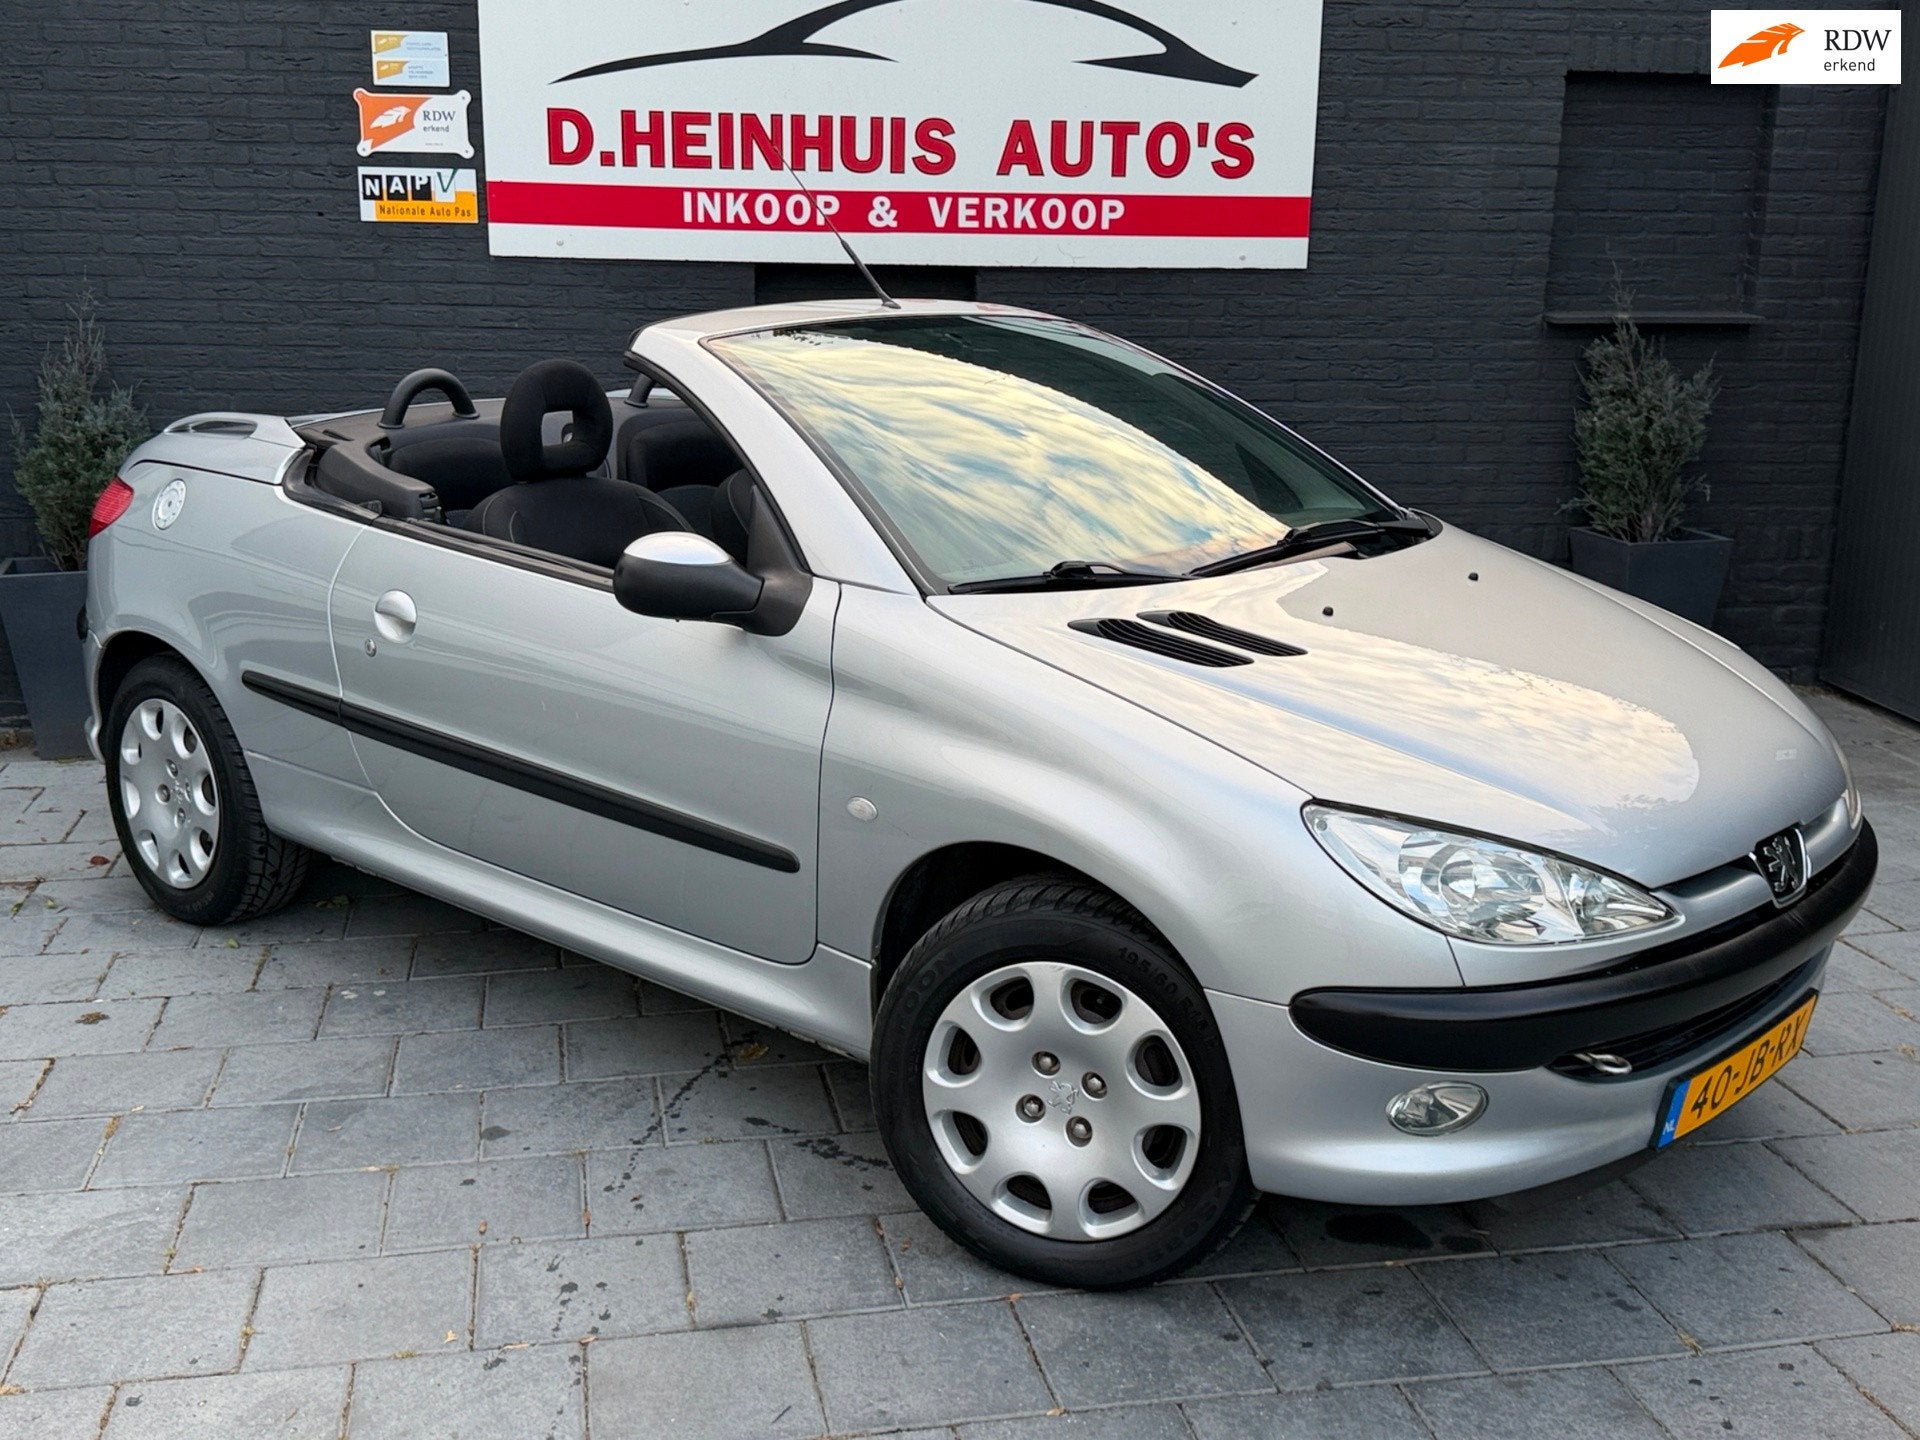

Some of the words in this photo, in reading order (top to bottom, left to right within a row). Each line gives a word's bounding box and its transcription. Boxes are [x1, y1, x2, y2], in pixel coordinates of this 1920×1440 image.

[422, 110, 456, 121] RDW
[422, 125, 450, 133] erkend
[546, 107, 957, 175] D.HEINHUIS
[996, 119, 1255, 179] AUTO'S
[379, 205, 426, 216] Nationale
[429, 206, 451, 217] Auto
[454, 207, 471, 217] Pas
[682, 191, 841, 226] INKOOP
[867, 196, 899, 228] &
[927, 196, 1126, 230] VERKOOP
[1690, 1010, 1807, 1119] 40-JB-RX
